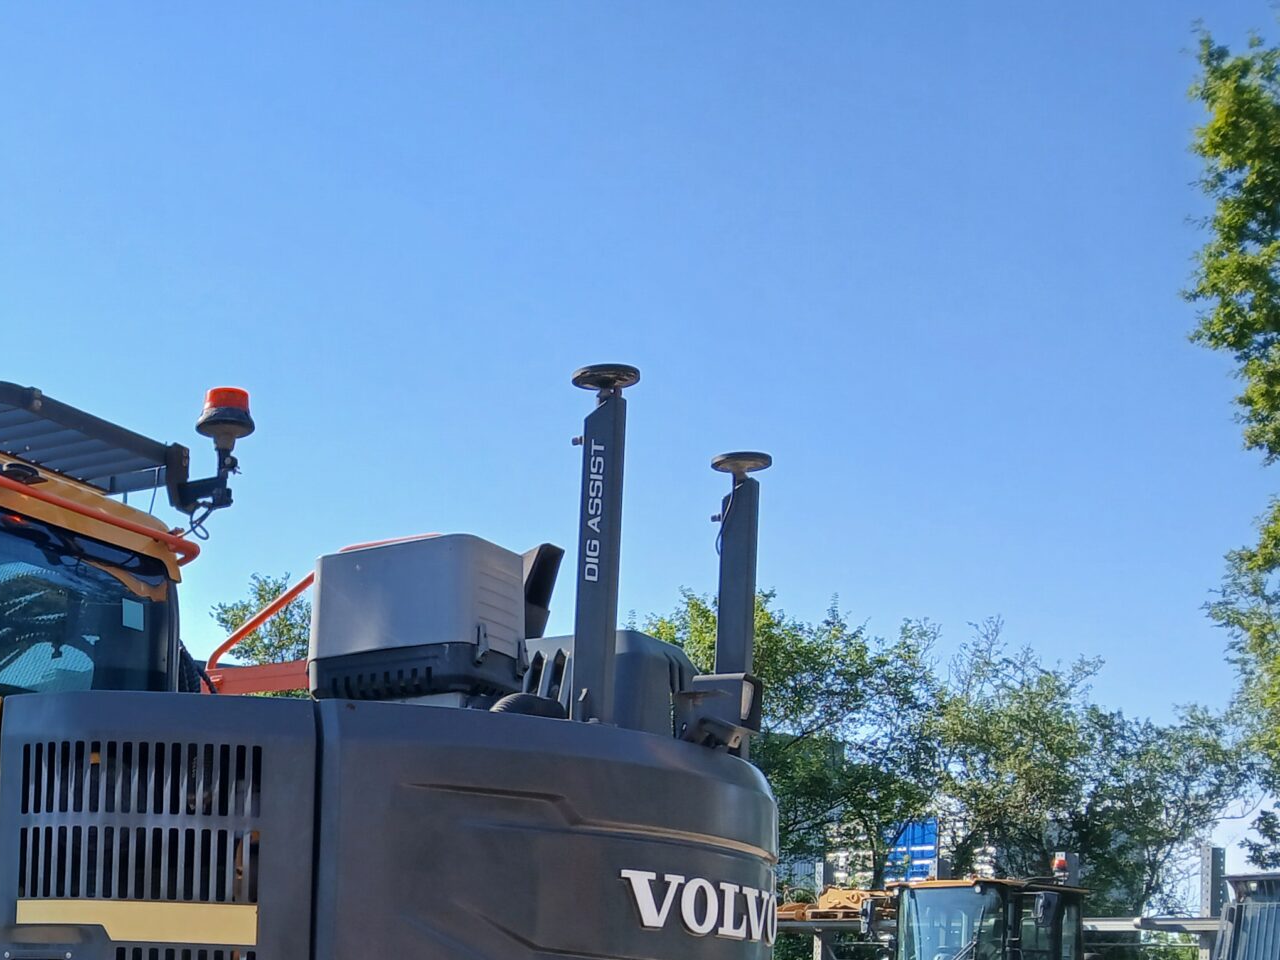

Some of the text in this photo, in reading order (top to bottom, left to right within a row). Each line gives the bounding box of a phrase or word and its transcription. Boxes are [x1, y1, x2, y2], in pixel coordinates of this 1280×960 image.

[584, 438, 605, 582] DIG ASSIST
[621, 869, 778, 946] VOLVO
